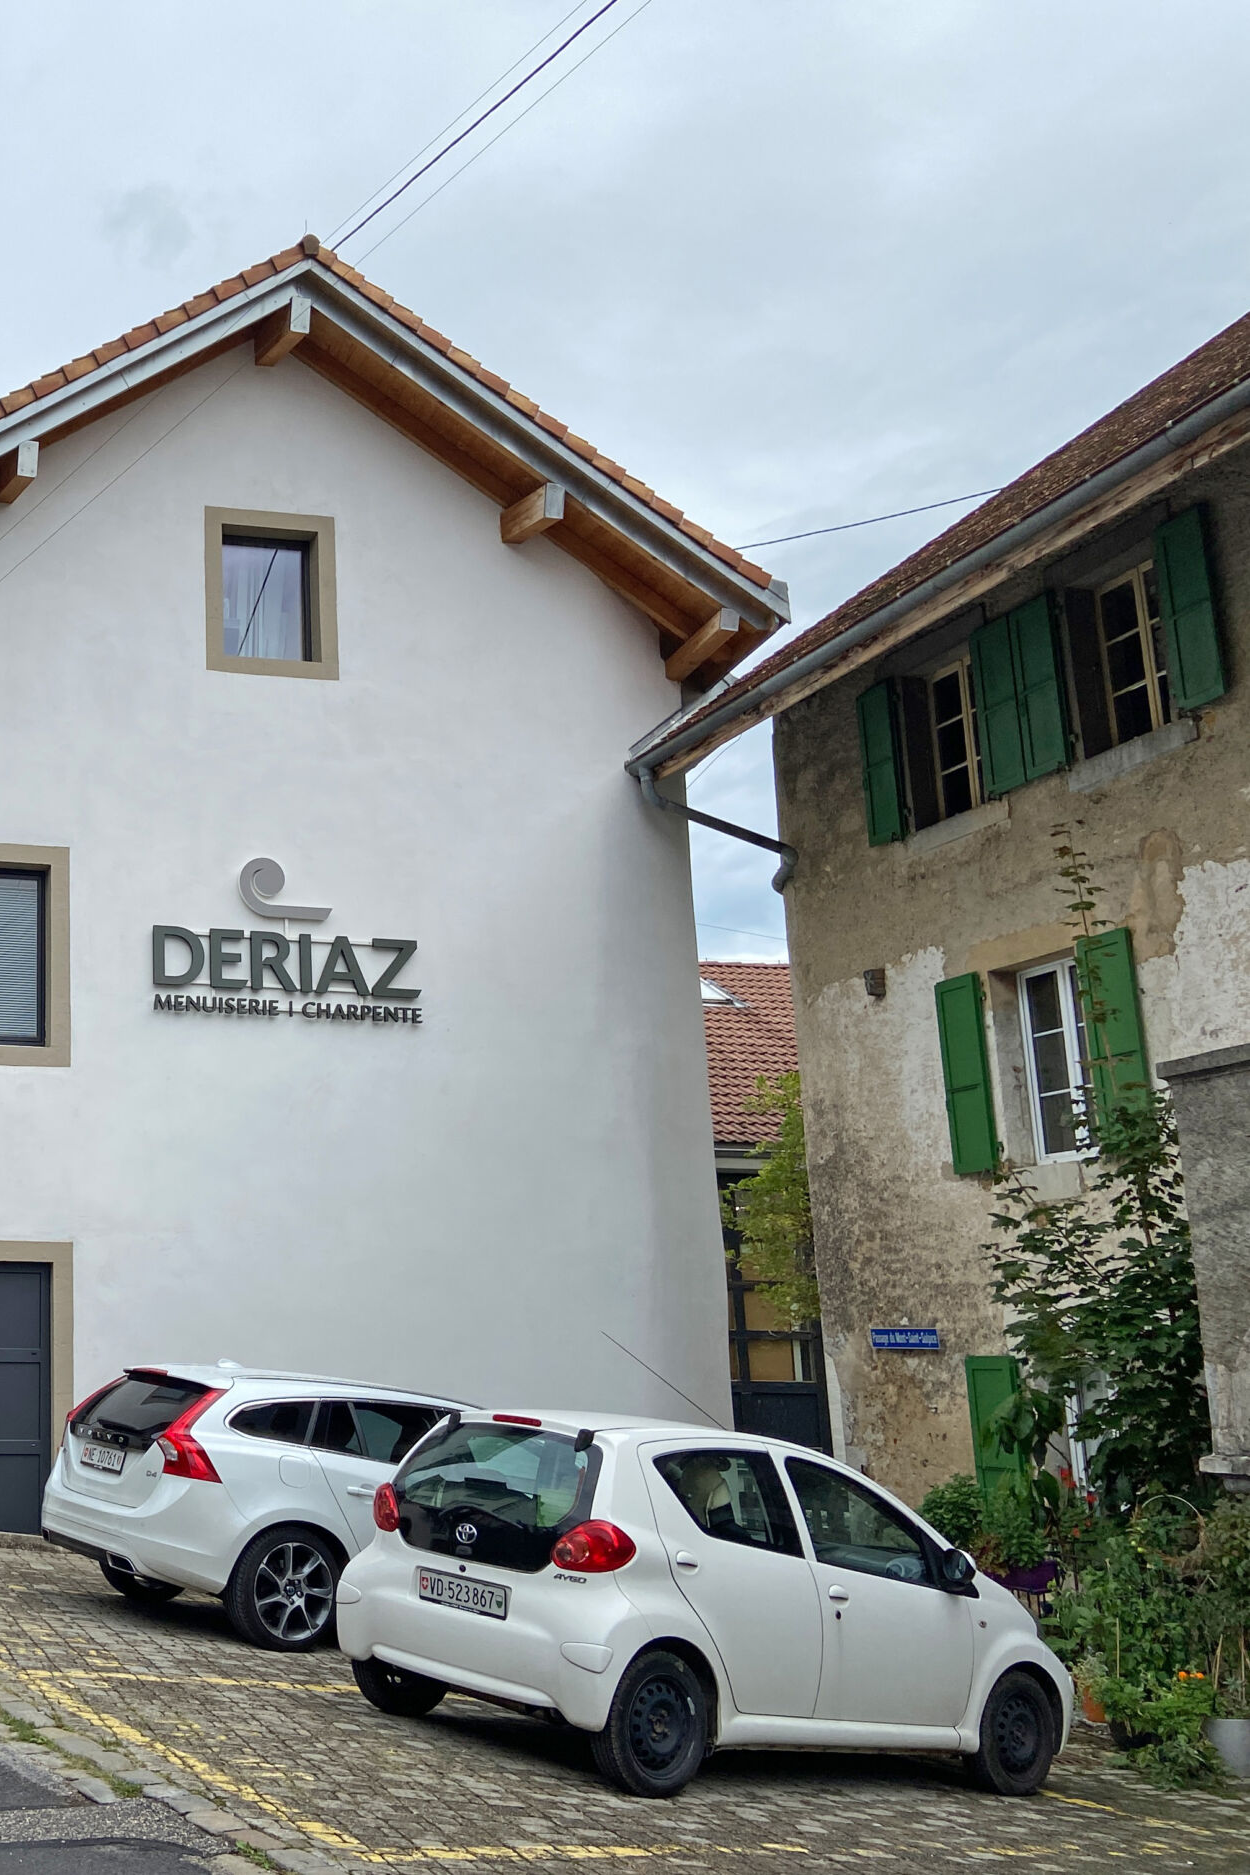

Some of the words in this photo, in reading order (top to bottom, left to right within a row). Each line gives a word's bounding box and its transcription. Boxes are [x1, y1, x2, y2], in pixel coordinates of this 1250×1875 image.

[153, 925, 422, 998] DERIAZ
[153, 994, 280, 1017] MENUISERIE
[302, 1001, 423, 1024] CHARPENTE
[554, 1573, 587, 1584] AYGO
